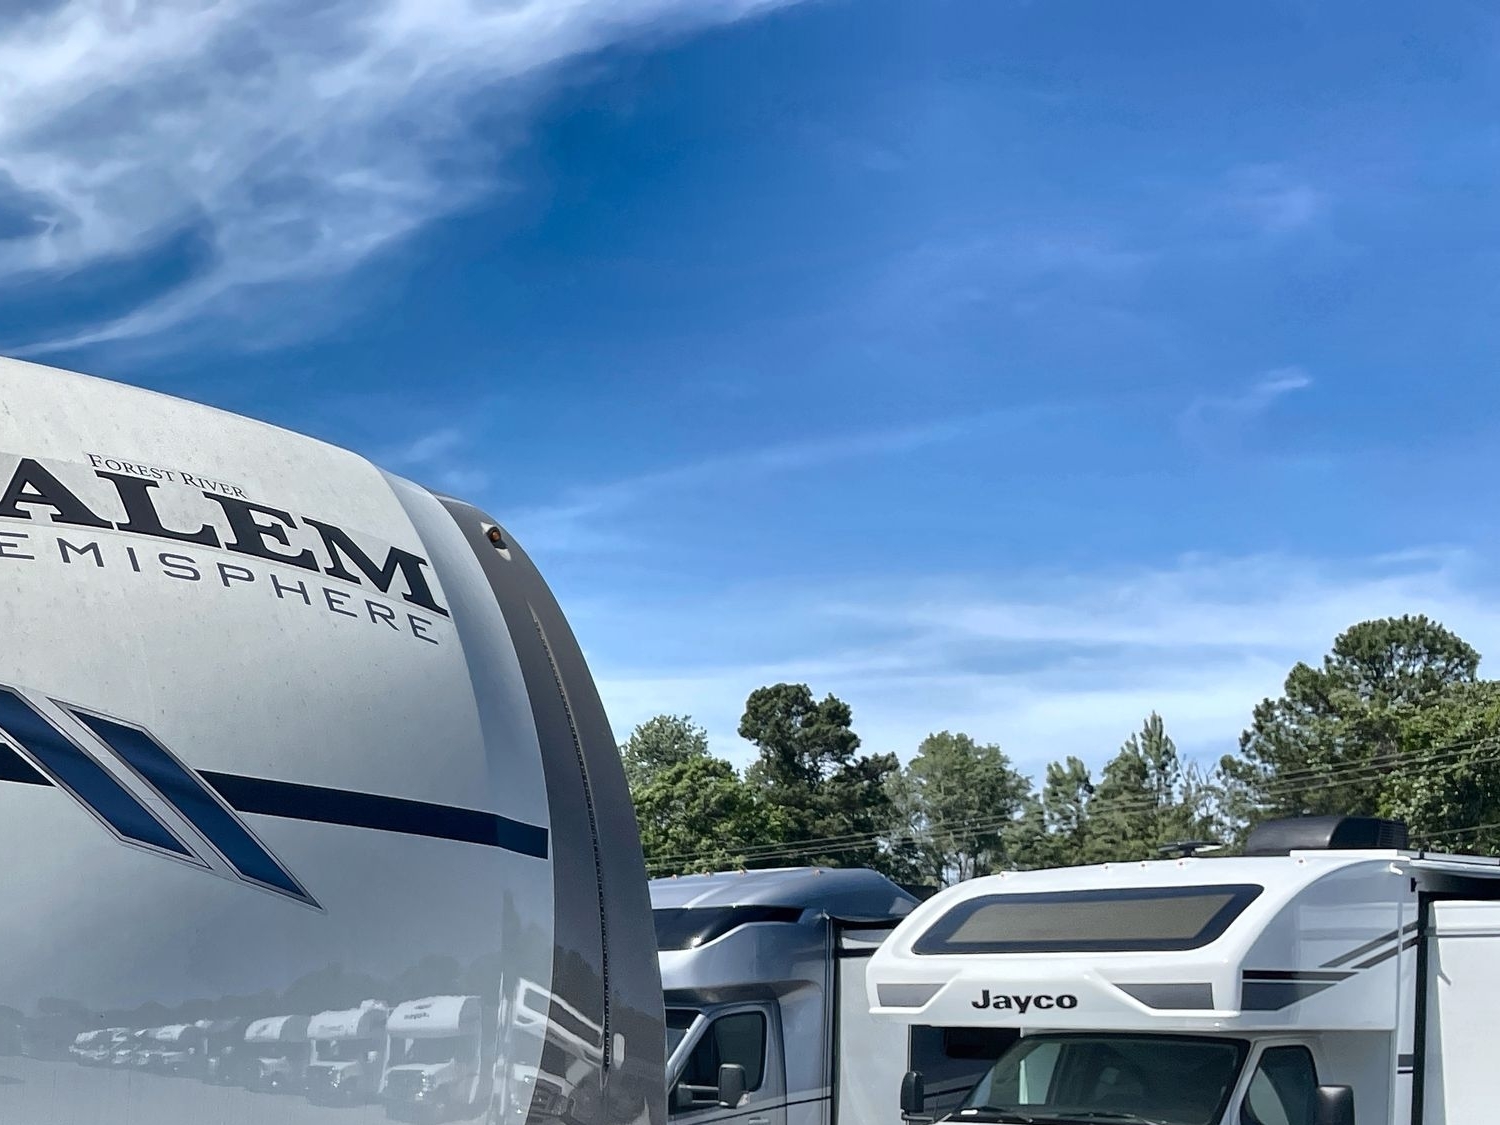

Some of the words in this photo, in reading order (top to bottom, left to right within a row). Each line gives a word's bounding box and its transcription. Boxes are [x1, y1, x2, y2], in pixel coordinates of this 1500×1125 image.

[87, 453, 175, 482] FOREST
[180, 471, 249, 499] RIVER
[971, 989, 1078, 1014] Jayco
